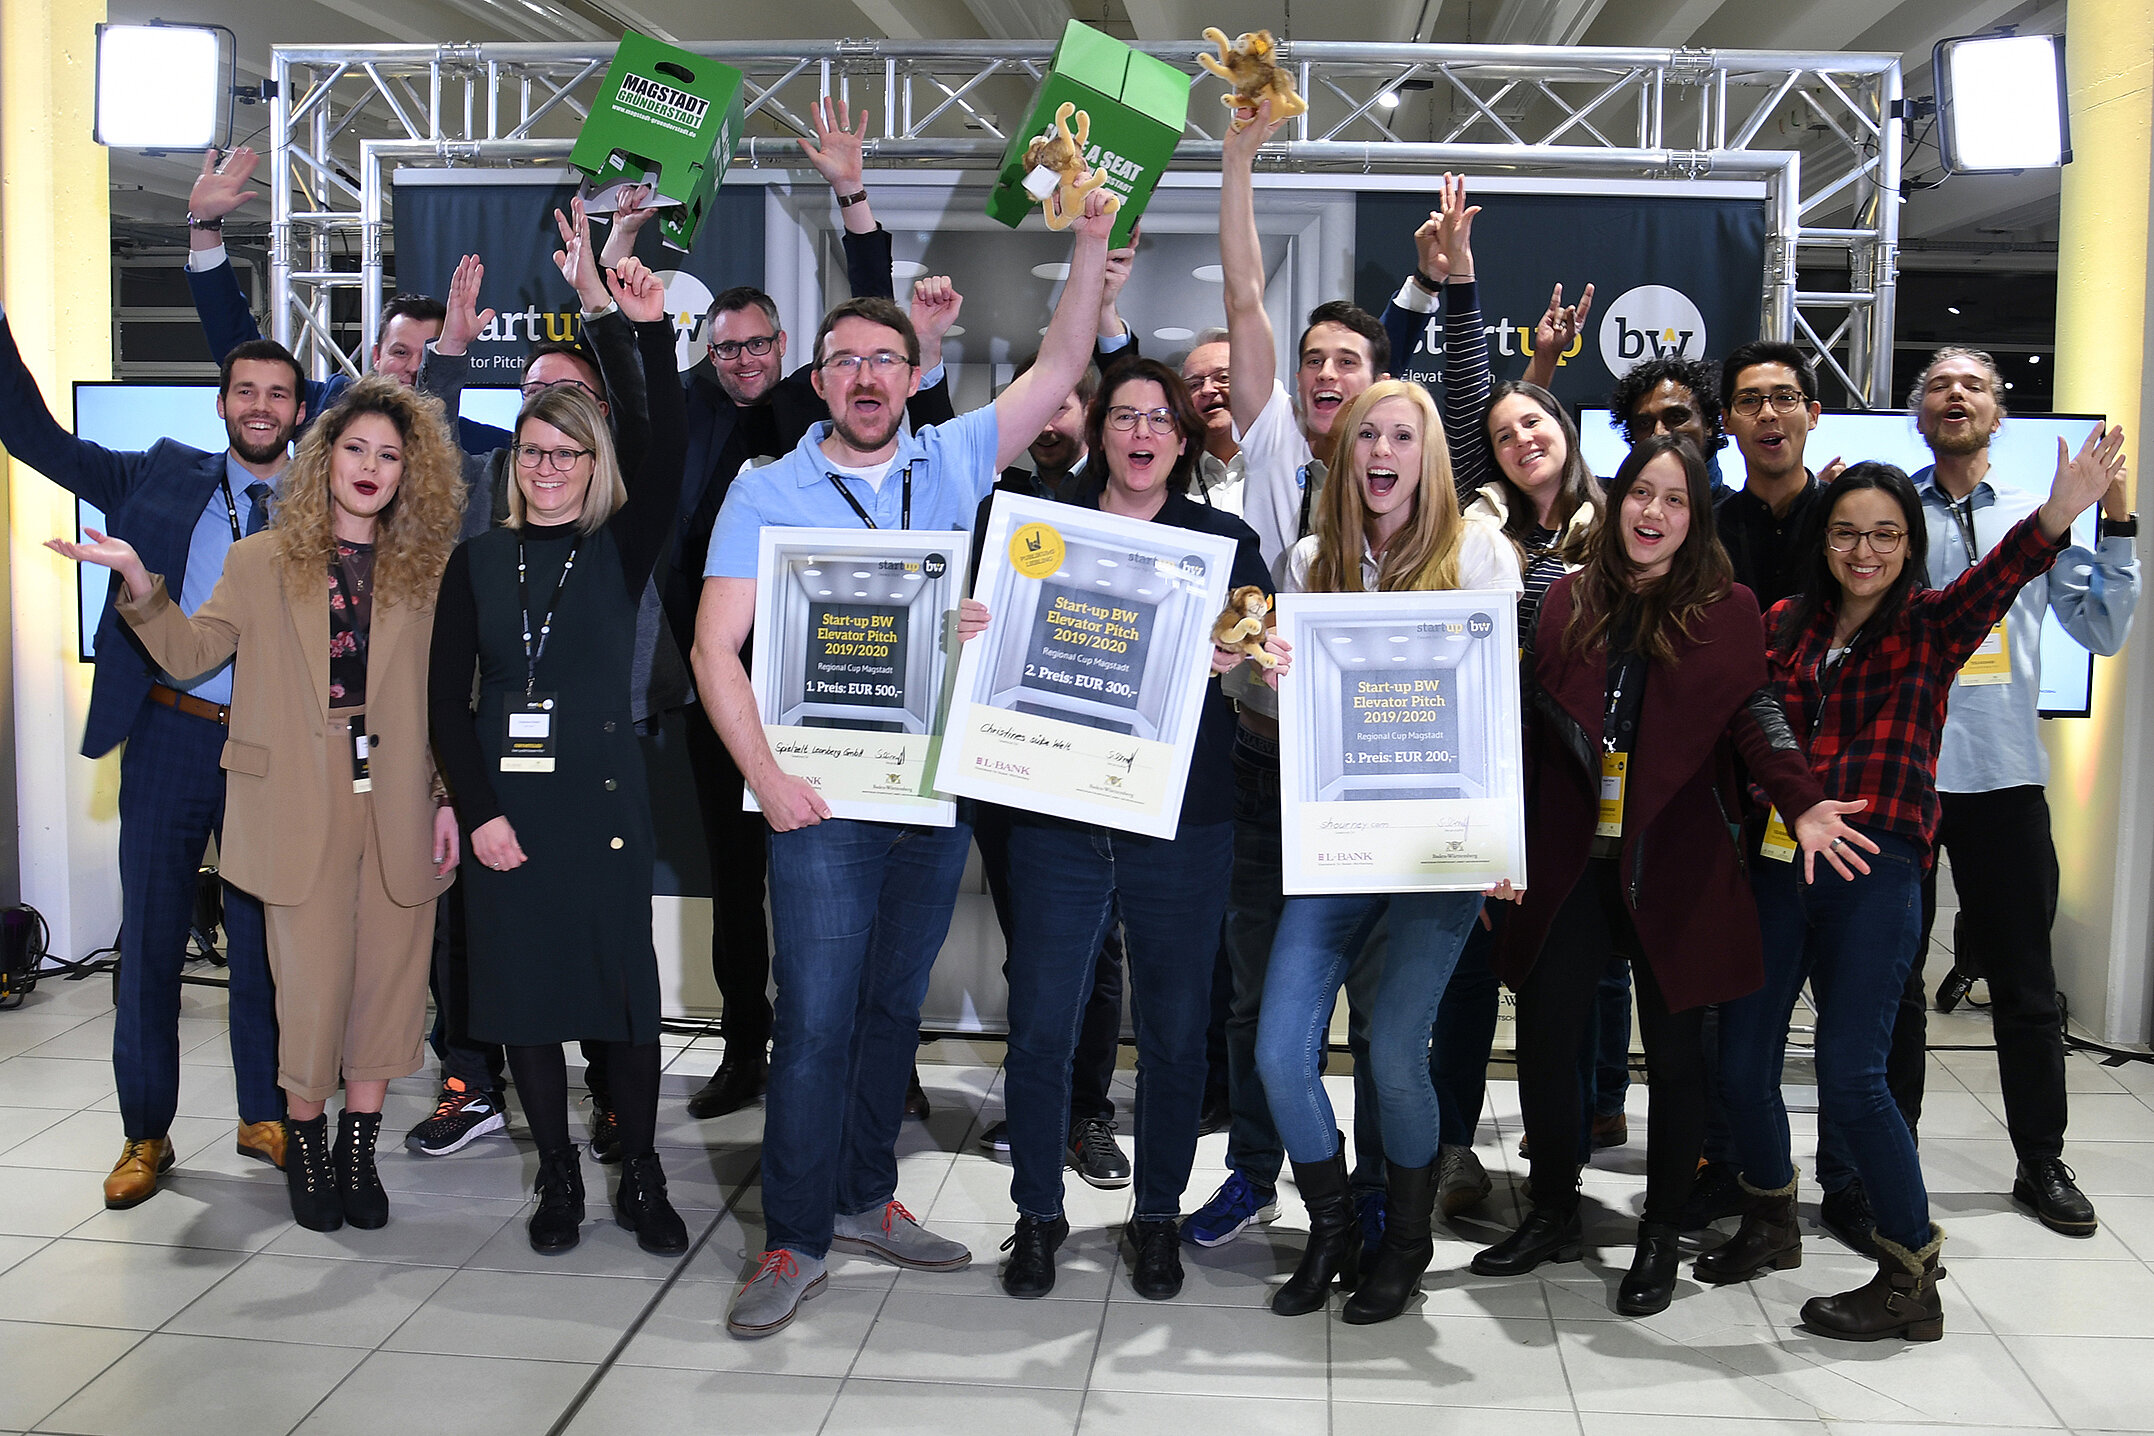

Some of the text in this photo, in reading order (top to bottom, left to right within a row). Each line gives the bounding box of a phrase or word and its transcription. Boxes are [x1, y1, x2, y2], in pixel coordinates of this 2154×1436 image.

[622, 75, 709, 115] MAGSTADT
[617, 90, 702, 128] GRÜNDERSTADT
[612, 104, 697, 138] www.magstadt-gruenderstadt.de
[1099, 151, 1144, 182] SEAT
[878, 560, 920, 573] startup
[925, 560, 944, 572] bw
[1054, 596, 1139, 624] Start-up BW
[822, 613, 894, 629] Start-up BW
[1046, 610, 1140, 642] Elevator Pitch
[1416, 622, 1464, 634] startup
[1469, 619, 1491, 632] bw
[817, 627, 898, 643] Elevator Pitch
[1053, 627, 1128, 655] 2019/2020
[824, 643, 889, 658] 2019/2020
[1042, 646, 1130, 673] Regional Cup Magstadt
[817, 662, 893, 675] Regional Cup Magstadt
[1025, 664, 1036, 678] 2.
[1038, 666, 1073, 687] Preis:
[1074, 674, 1104, 691] EUR
[806, 681, 815, 693] 1.
[817, 681, 847, 694] Preis:
[848, 683, 873, 696] EUR
[1357, 680, 1440, 694] Start-up BW
[1353, 695, 1446, 709] Elevator Pitch
[1363, 710, 1437, 724] 2019/2020
[1357, 731, 1444, 742] Regional Cup Magstadt
[1345, 752, 1356, 764] 3.
[1358, 752, 1393, 764] Preis:
[1394, 751, 1422, 763] EUR
